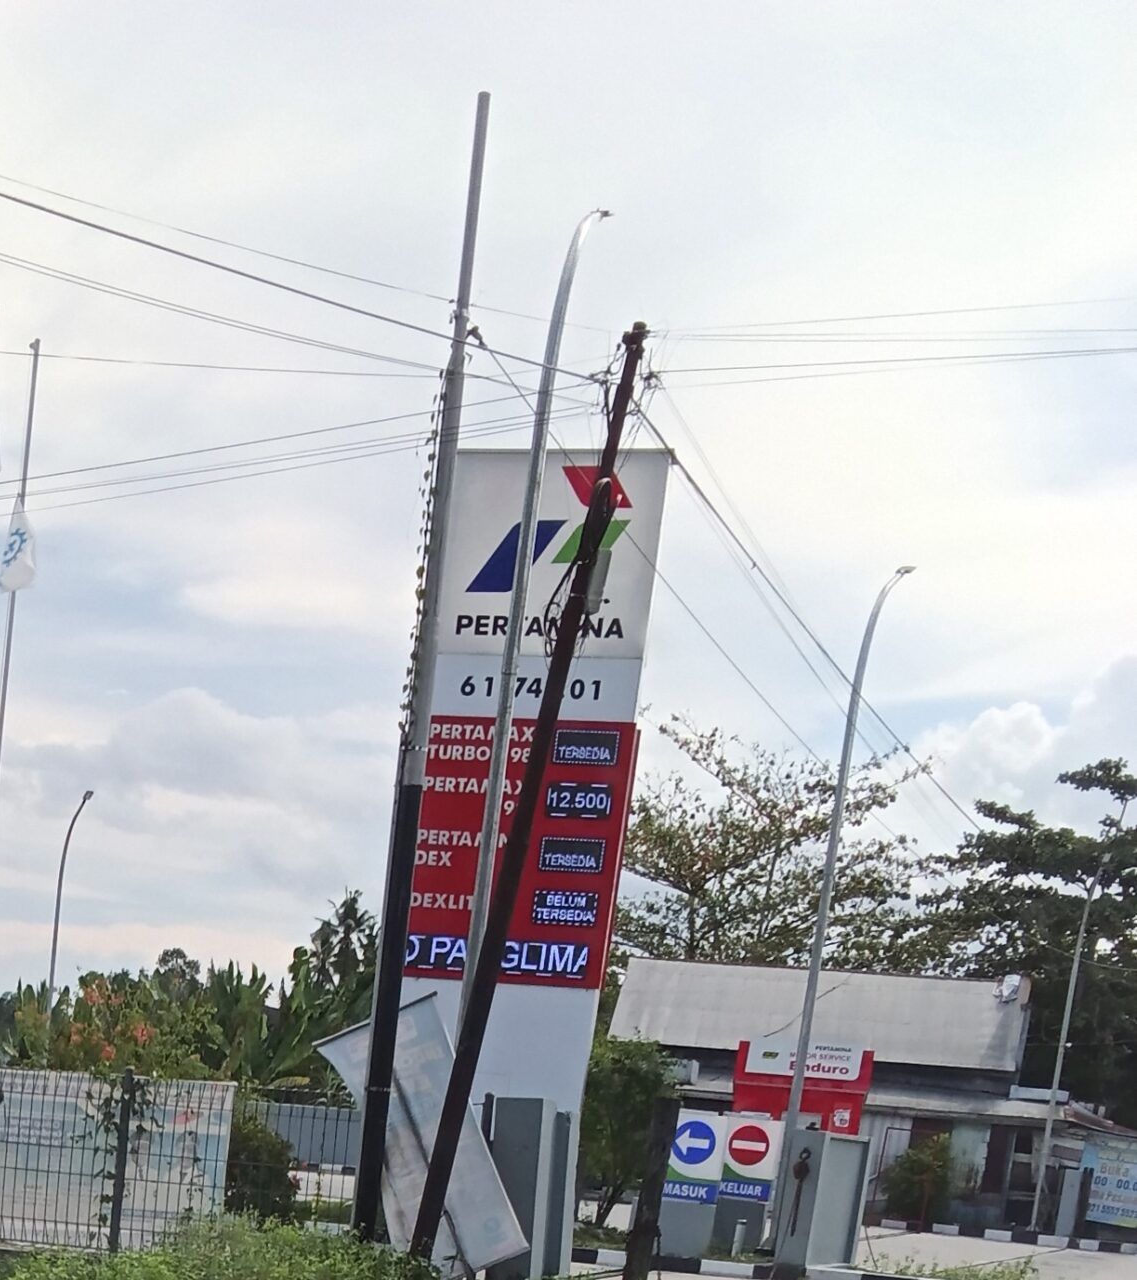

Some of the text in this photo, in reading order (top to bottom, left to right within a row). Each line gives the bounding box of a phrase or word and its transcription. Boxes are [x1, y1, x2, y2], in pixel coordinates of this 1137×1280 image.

[428, 744, 491, 762] TURBO
[558, 745, 611, 761] TERSEDIA
[550, 790, 607, 809] 12.500
[414, 850, 453, 867] DEX
[544, 852, 597, 868] TERSEDIA
[410, 892, 475, 911] DEXLIT
[546, 895, 587, 908] BELUM
[536, 907, 596, 923] TERSEDIA
[429, 937, 589, 973] PAGLIMA
[663, 1182, 709, 1199] MASUK
[719, 1181, 762, 1196] KELUAR
